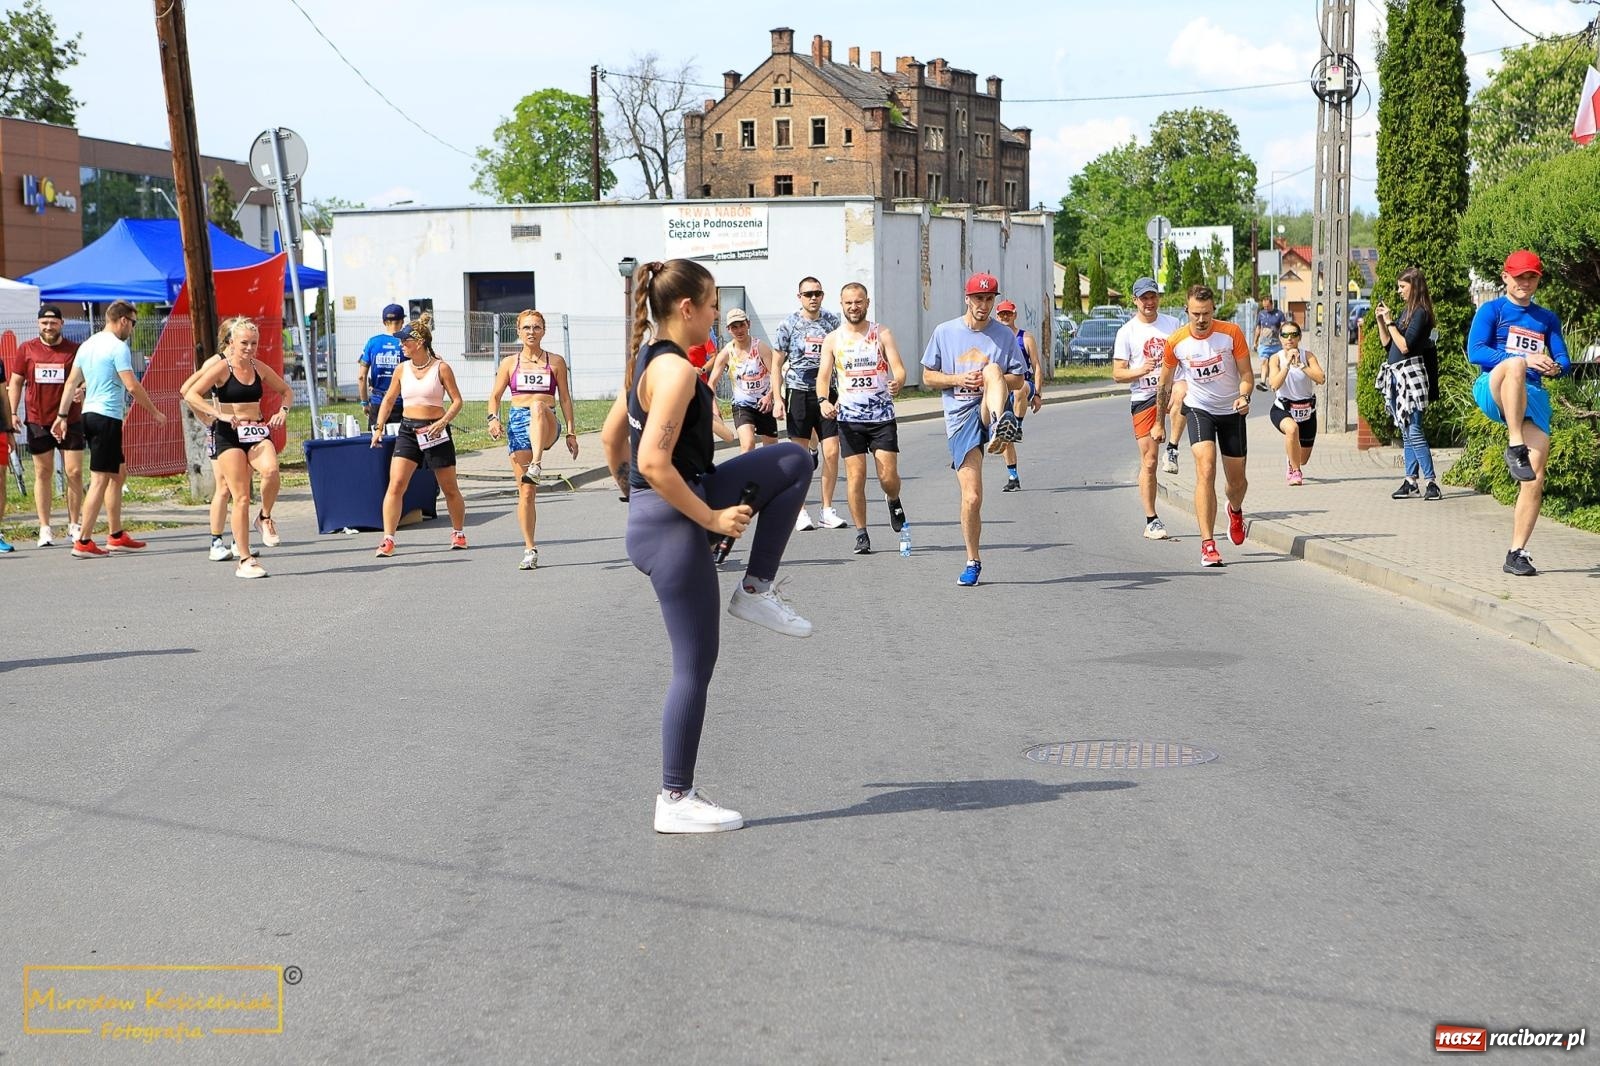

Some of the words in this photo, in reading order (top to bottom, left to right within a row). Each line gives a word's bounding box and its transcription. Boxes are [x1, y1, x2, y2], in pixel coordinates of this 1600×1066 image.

[678, 207, 712, 218] TRWA
[715, 204, 752, 218] NABÓR
[668, 218, 701, 230] Sekcja
[703, 218, 763, 229] Podnoszenia
[668, 229, 711, 240] Ciężarów
[1515, 335, 1538, 351] 155
[42, 369, 58, 378] 217
[1196, 365, 1220, 377] 144
[523, 375, 544, 385] 192
[851, 377, 873, 388] 233
[1145, 376, 1160, 386] 13
[243, 427, 266, 436] 200
